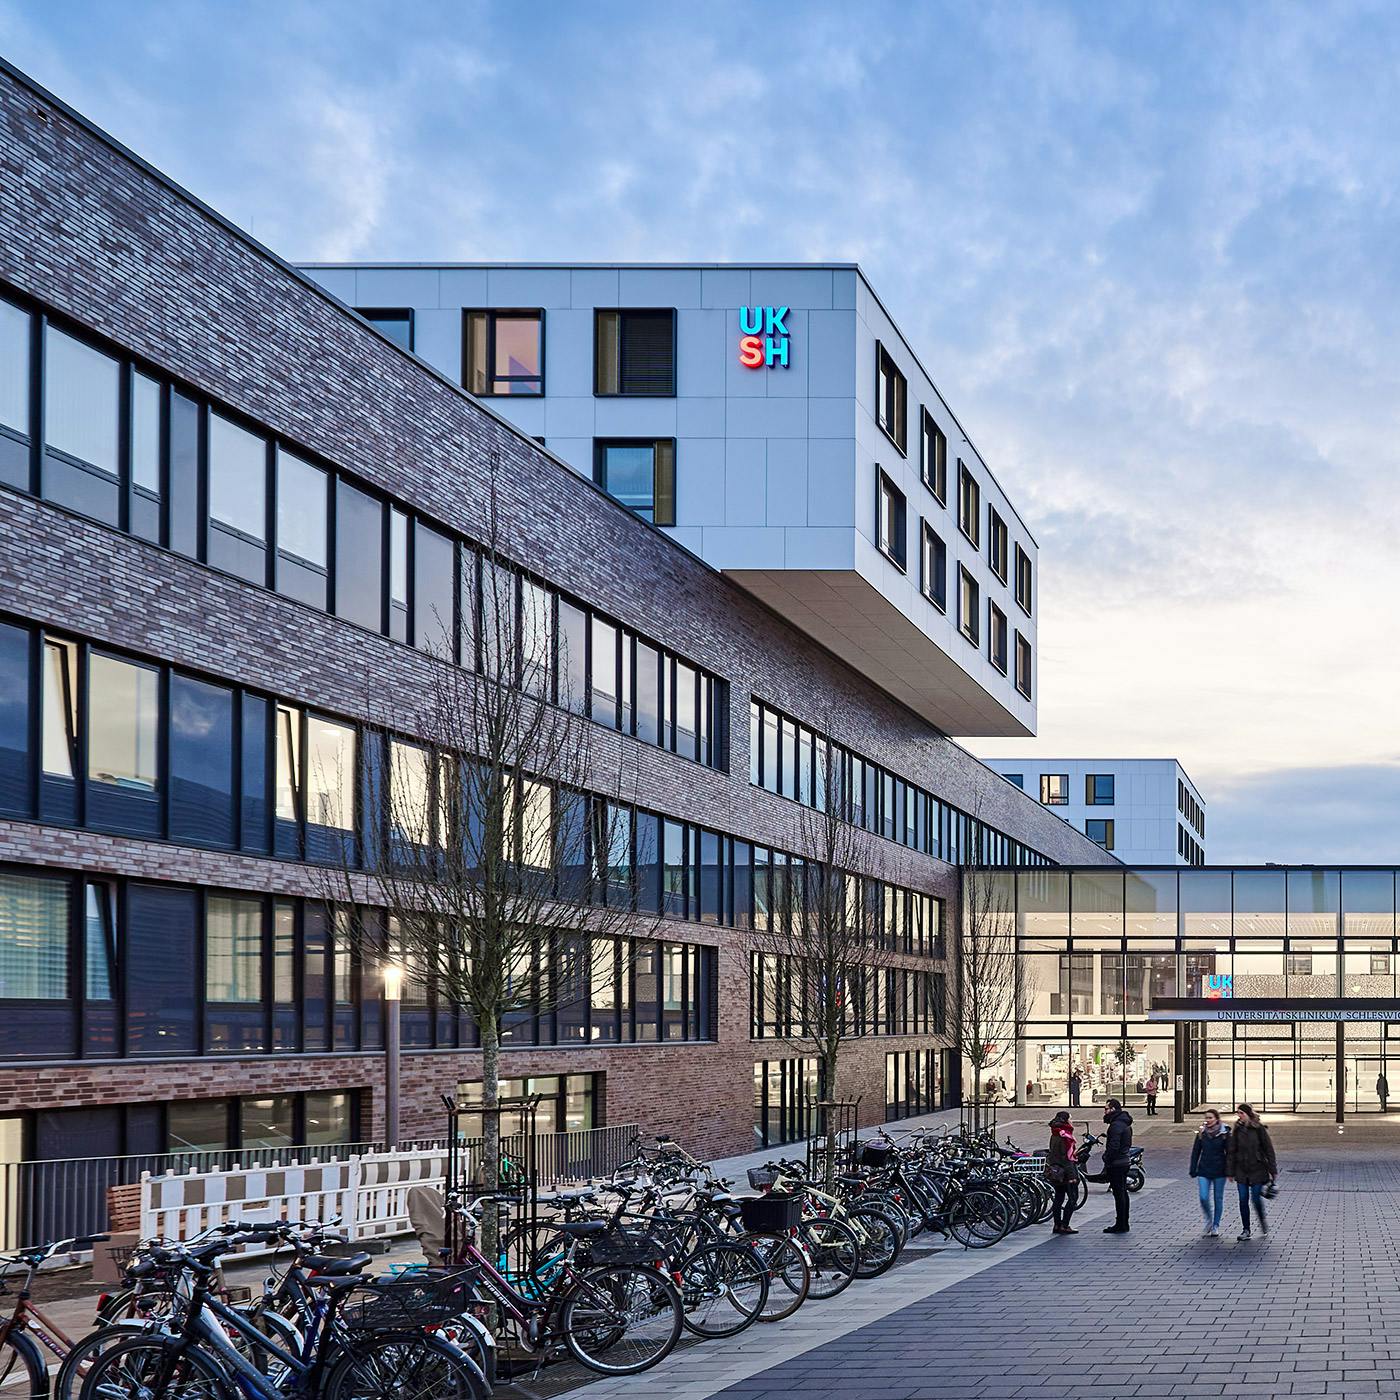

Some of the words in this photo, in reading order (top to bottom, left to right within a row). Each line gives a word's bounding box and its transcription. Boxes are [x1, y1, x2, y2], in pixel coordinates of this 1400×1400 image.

[739, 306, 790, 336] UK
[739, 336, 790, 369] SH
[1209, 974, 1232, 989] UK
